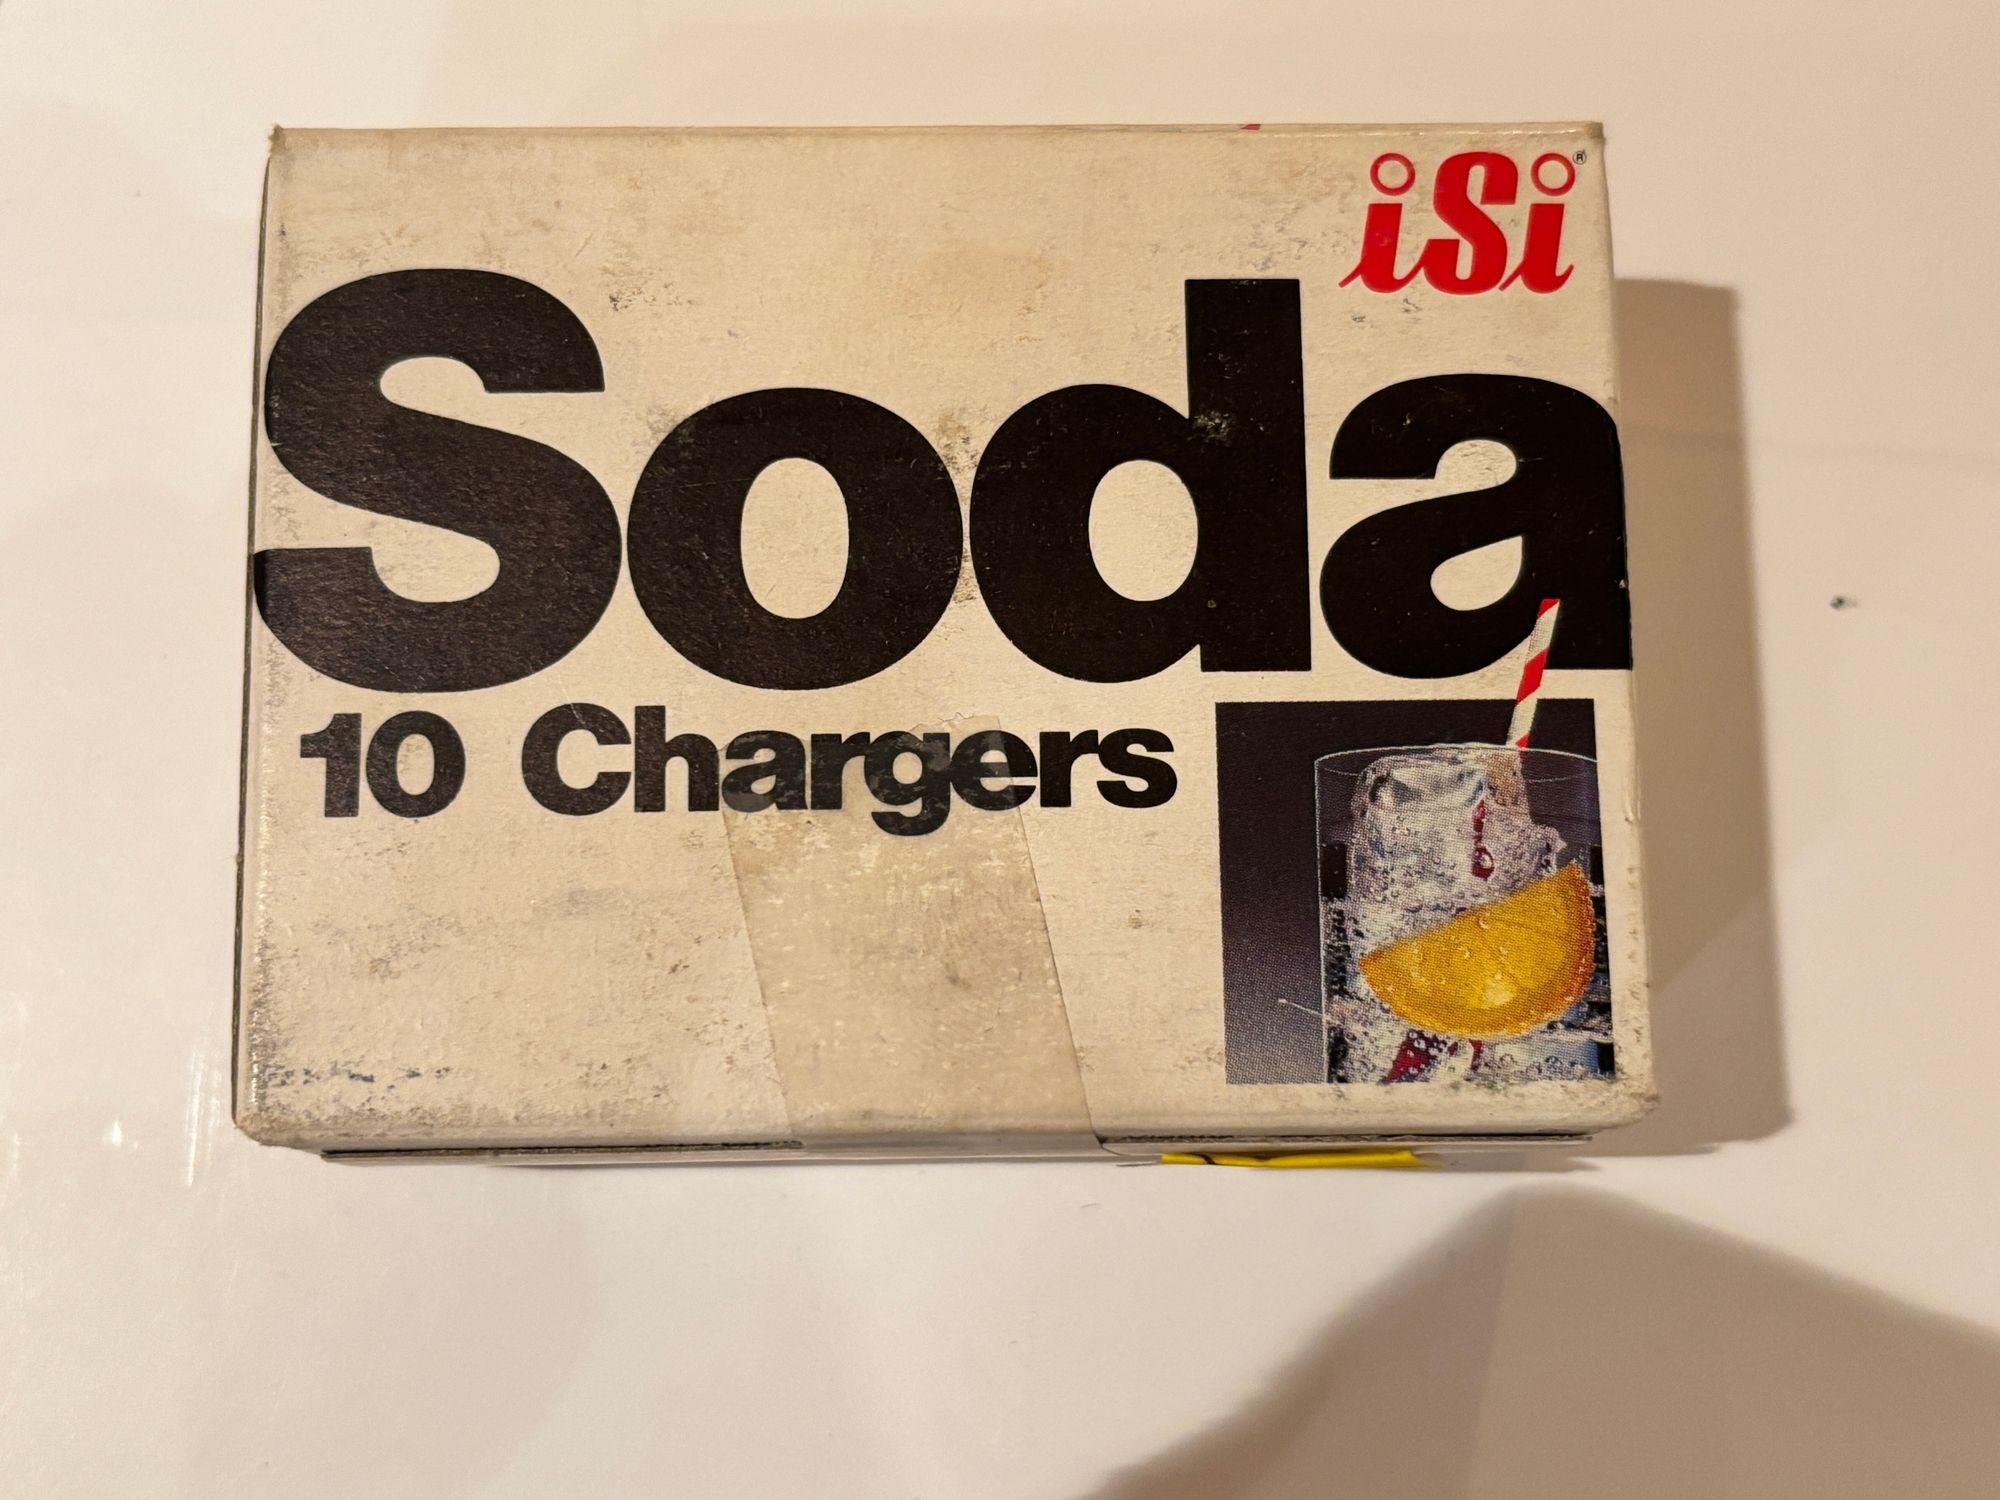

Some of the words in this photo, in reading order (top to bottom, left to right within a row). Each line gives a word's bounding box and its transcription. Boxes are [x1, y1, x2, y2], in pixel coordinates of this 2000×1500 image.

[256, 267, 1634, 692] Soda
[299, 710, 467, 819] 10
[521, 702, 1178, 837] Chargers
